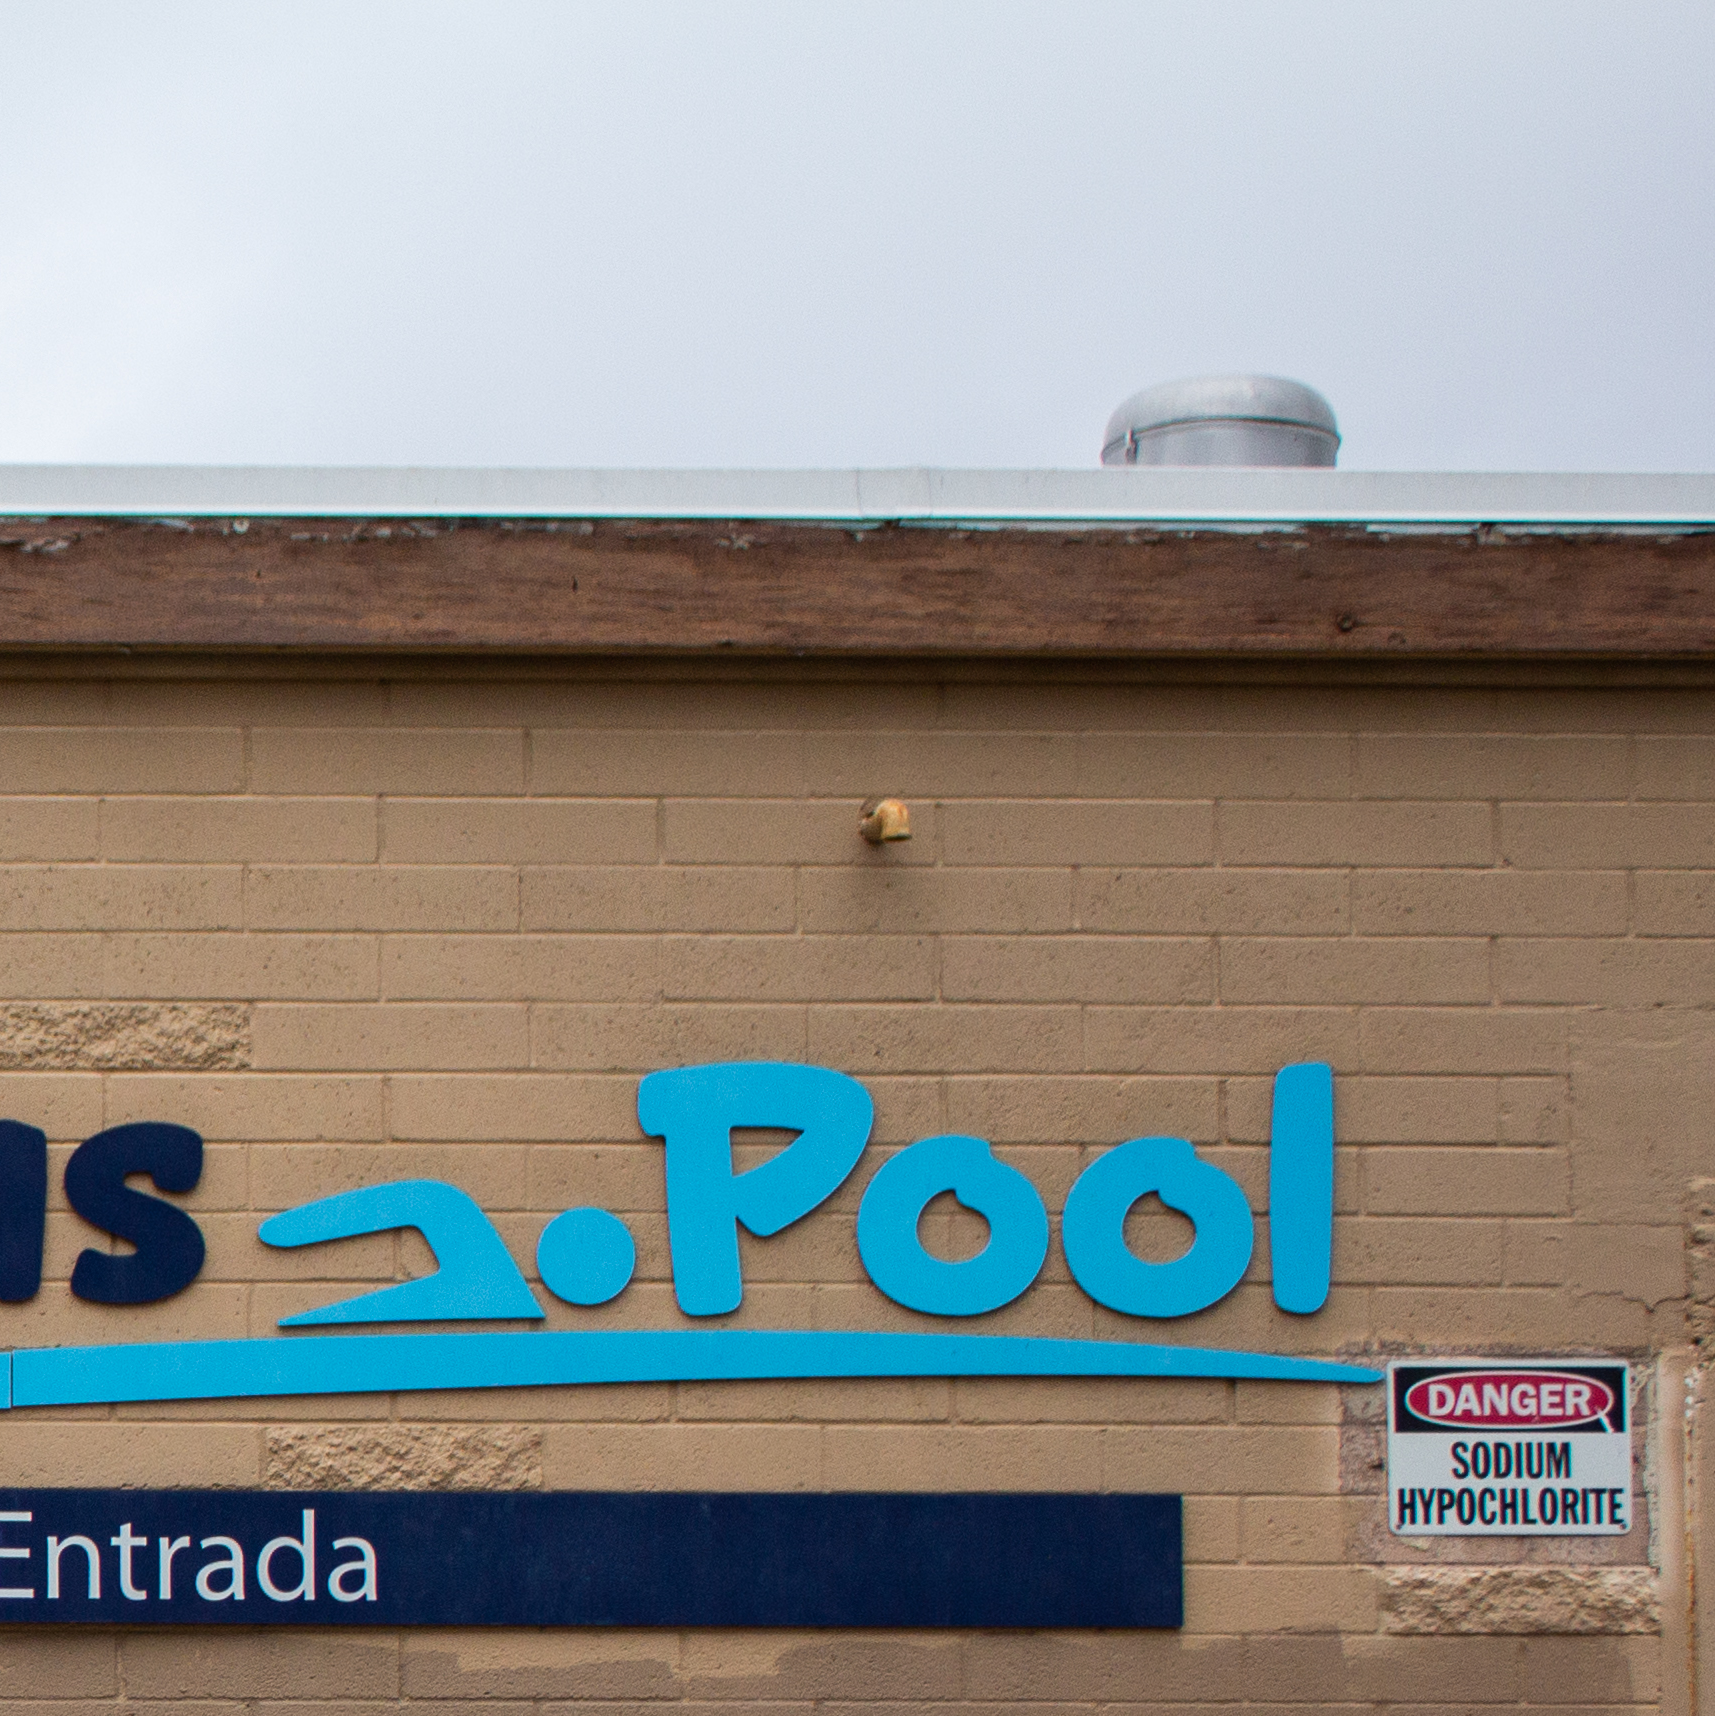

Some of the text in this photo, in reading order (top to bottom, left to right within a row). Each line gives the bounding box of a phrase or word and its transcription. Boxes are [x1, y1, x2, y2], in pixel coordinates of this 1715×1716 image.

[637, 1061, 1333, 1318] Pool
[1427, 1382, 1592, 1418] DANGER
[1450, 1441, 1572, 1480] SODIUM
[1397, 1487, 1625, 1526] HYPOCHLORITE
